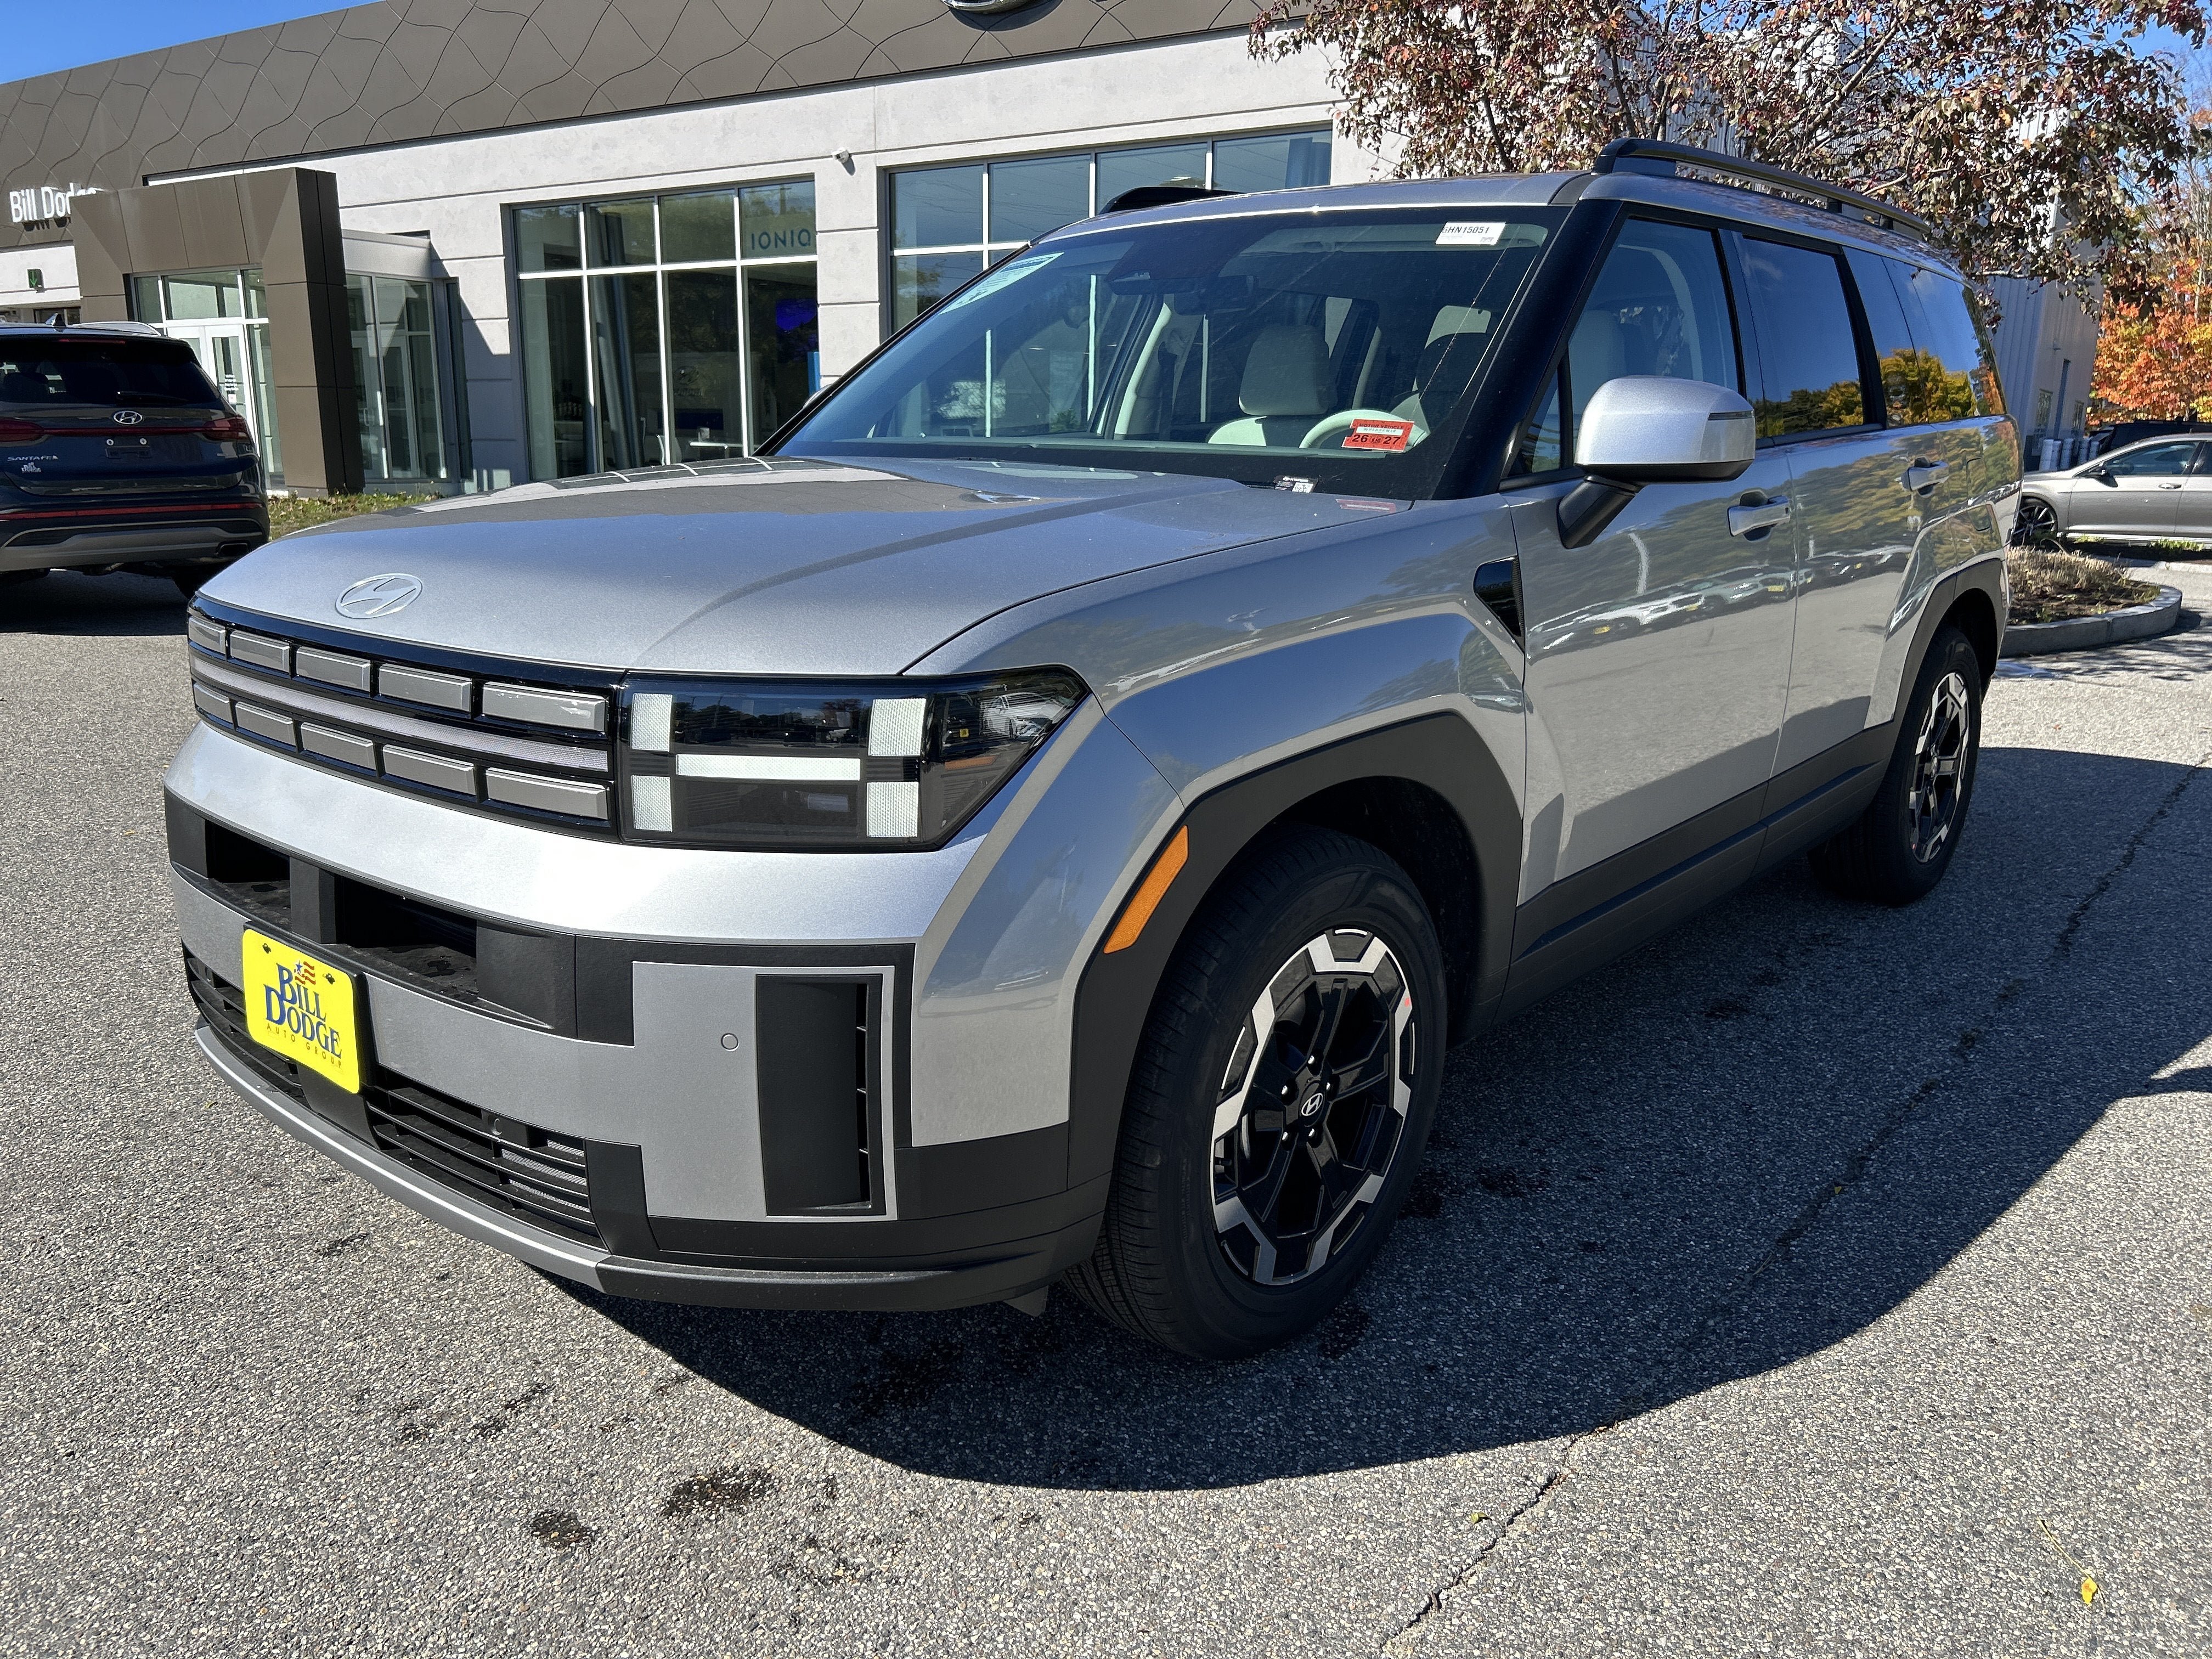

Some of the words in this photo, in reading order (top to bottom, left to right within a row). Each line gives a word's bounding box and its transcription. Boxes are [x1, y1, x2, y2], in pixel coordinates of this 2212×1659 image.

[10, 188, 37, 223] Bill
[41, 182, 97, 218] Dod
[751, 228, 811, 250] IONIQ
[1352, 434, 1369, 443] 26
[1383, 436, 1401, 445] 27
[276, 963, 326, 1023] BILL
[263, 984, 342, 1059] DODGE
[267, 1023, 296, 1042] AUTO
[306, 1042, 341, 1068] GROUP
